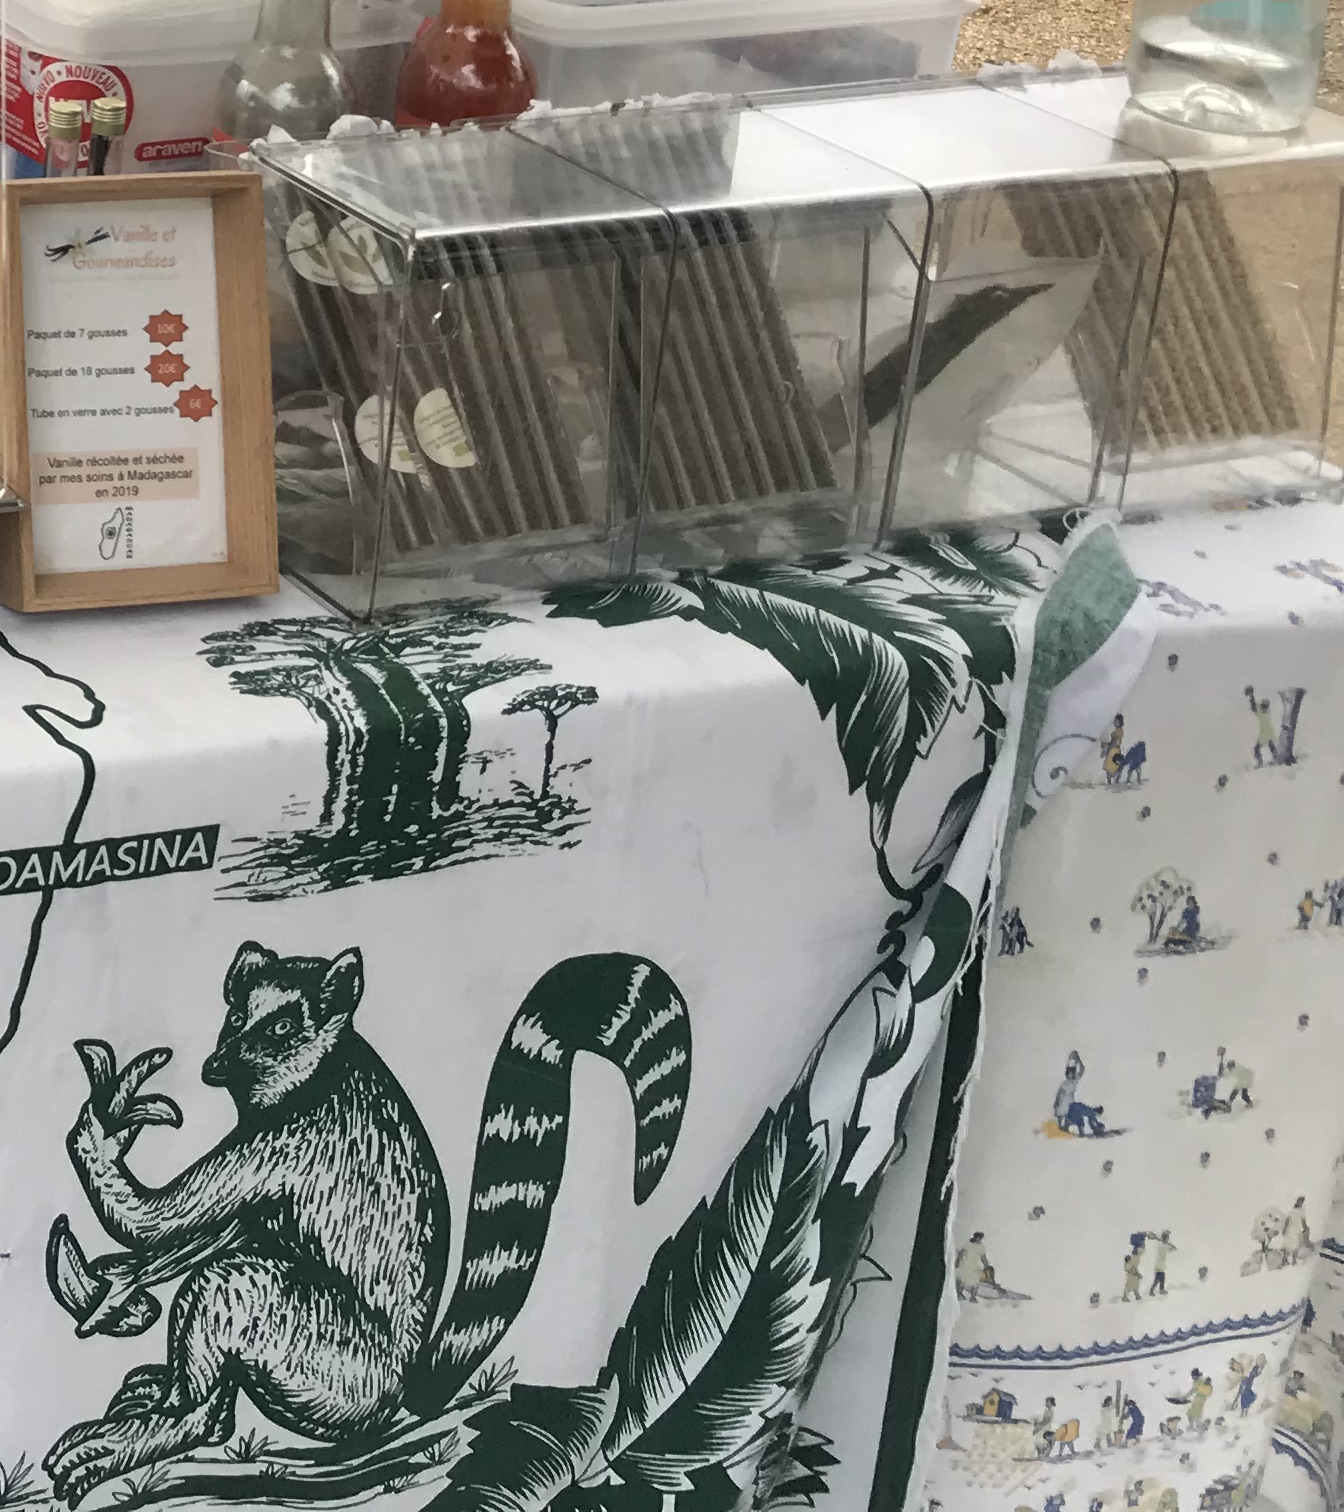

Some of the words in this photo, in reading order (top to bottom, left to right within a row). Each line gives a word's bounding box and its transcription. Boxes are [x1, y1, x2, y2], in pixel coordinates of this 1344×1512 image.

[64, 63, 116, 92] NOUVEAU
[142, 140, 204, 158] araven
[110, 223, 158, 243] Vanille
[162, 227, 177, 243] et
[72, 250, 177, 270] Gourmandises
[26, 329, 62, 341] Paquet
[63, 328, 76, 338] de
[79, 328, 85, 338] 7
[87, 328, 128, 341] gousses
[27, 367, 63, 379] Paquet
[64, 366, 78, 377] de
[81, 366, 93, 376] 18
[95, 366, 135, 378] gousses
[30, 408, 55, 418] Tube
[57, 409, 70, 418] en
[72, 408, 97, 418] verre
[99, 407, 123, 417] avec
[125, 405, 131, 416] 2
[134, 406, 175, 418] gousses
[46, 457, 83, 469] Vanille
[86, 455, 129, 468] récoltée
[132, 454, 143, 465] et
[145, 453, 185, 465] séchée
[38, 475, 57, 486] par
[59, 474, 83, 483] mes
[85, 472, 114, 483] soins
[117, 471, 124, 481] à
[127, 469, 193, 482] Madagascar
[94, 488, 109, 498] en
[111, 485, 139, 498] 2019
